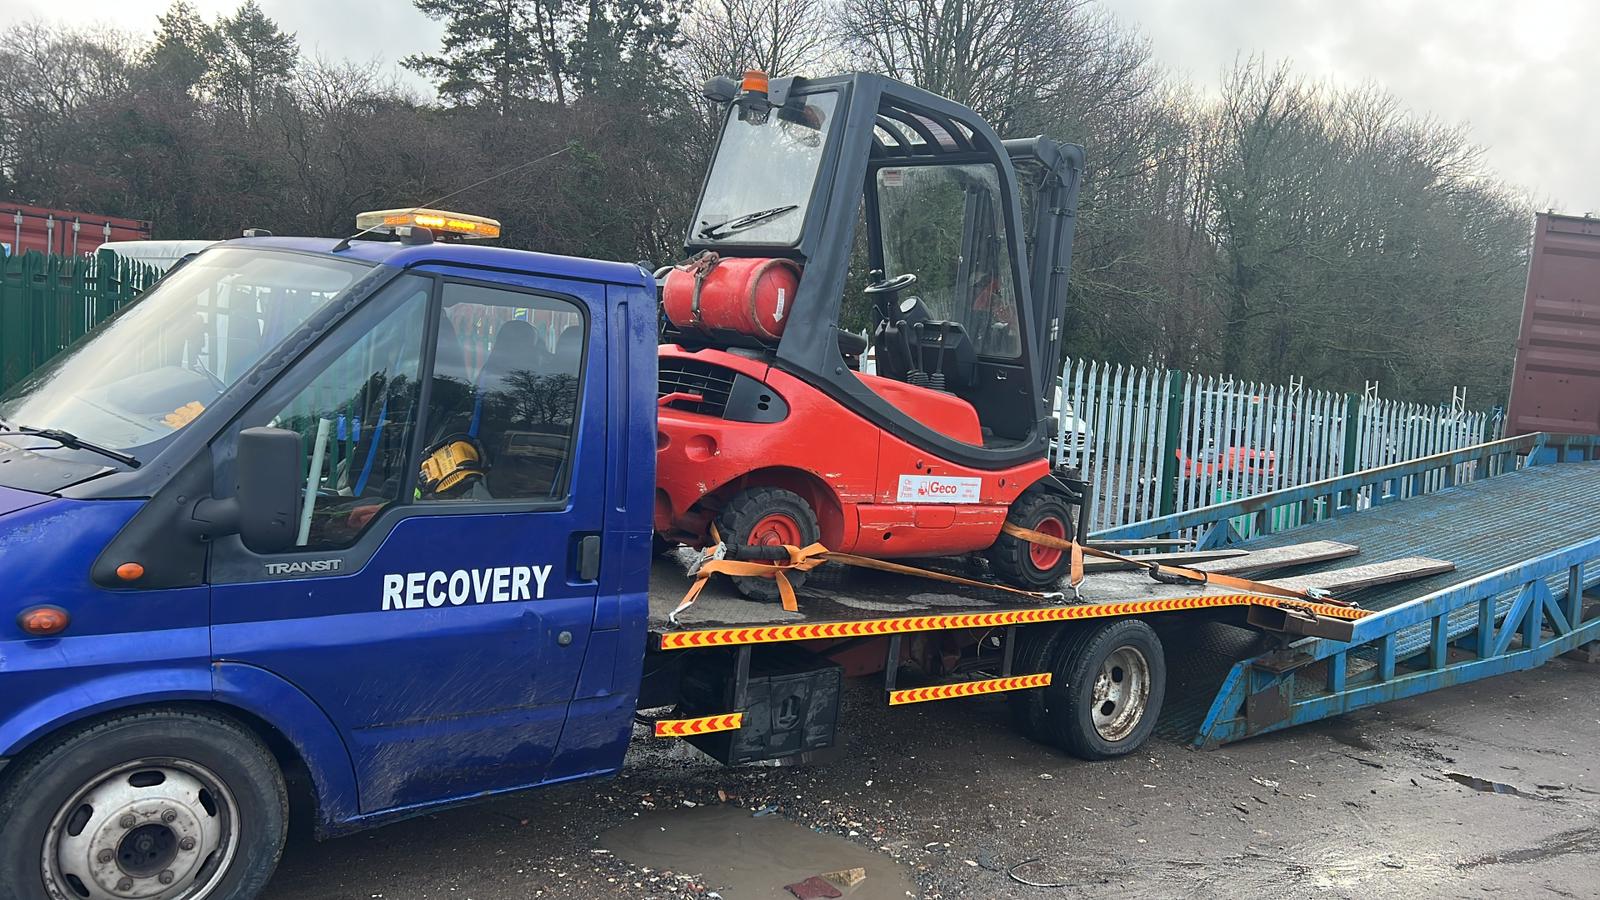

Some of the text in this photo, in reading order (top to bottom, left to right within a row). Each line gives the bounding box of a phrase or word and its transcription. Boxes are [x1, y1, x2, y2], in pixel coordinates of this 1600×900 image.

[930, 481, 957, 494] Geco
[265, 559, 342, 575] TRANSIT
[381, 564, 553, 611] RECOVERY
